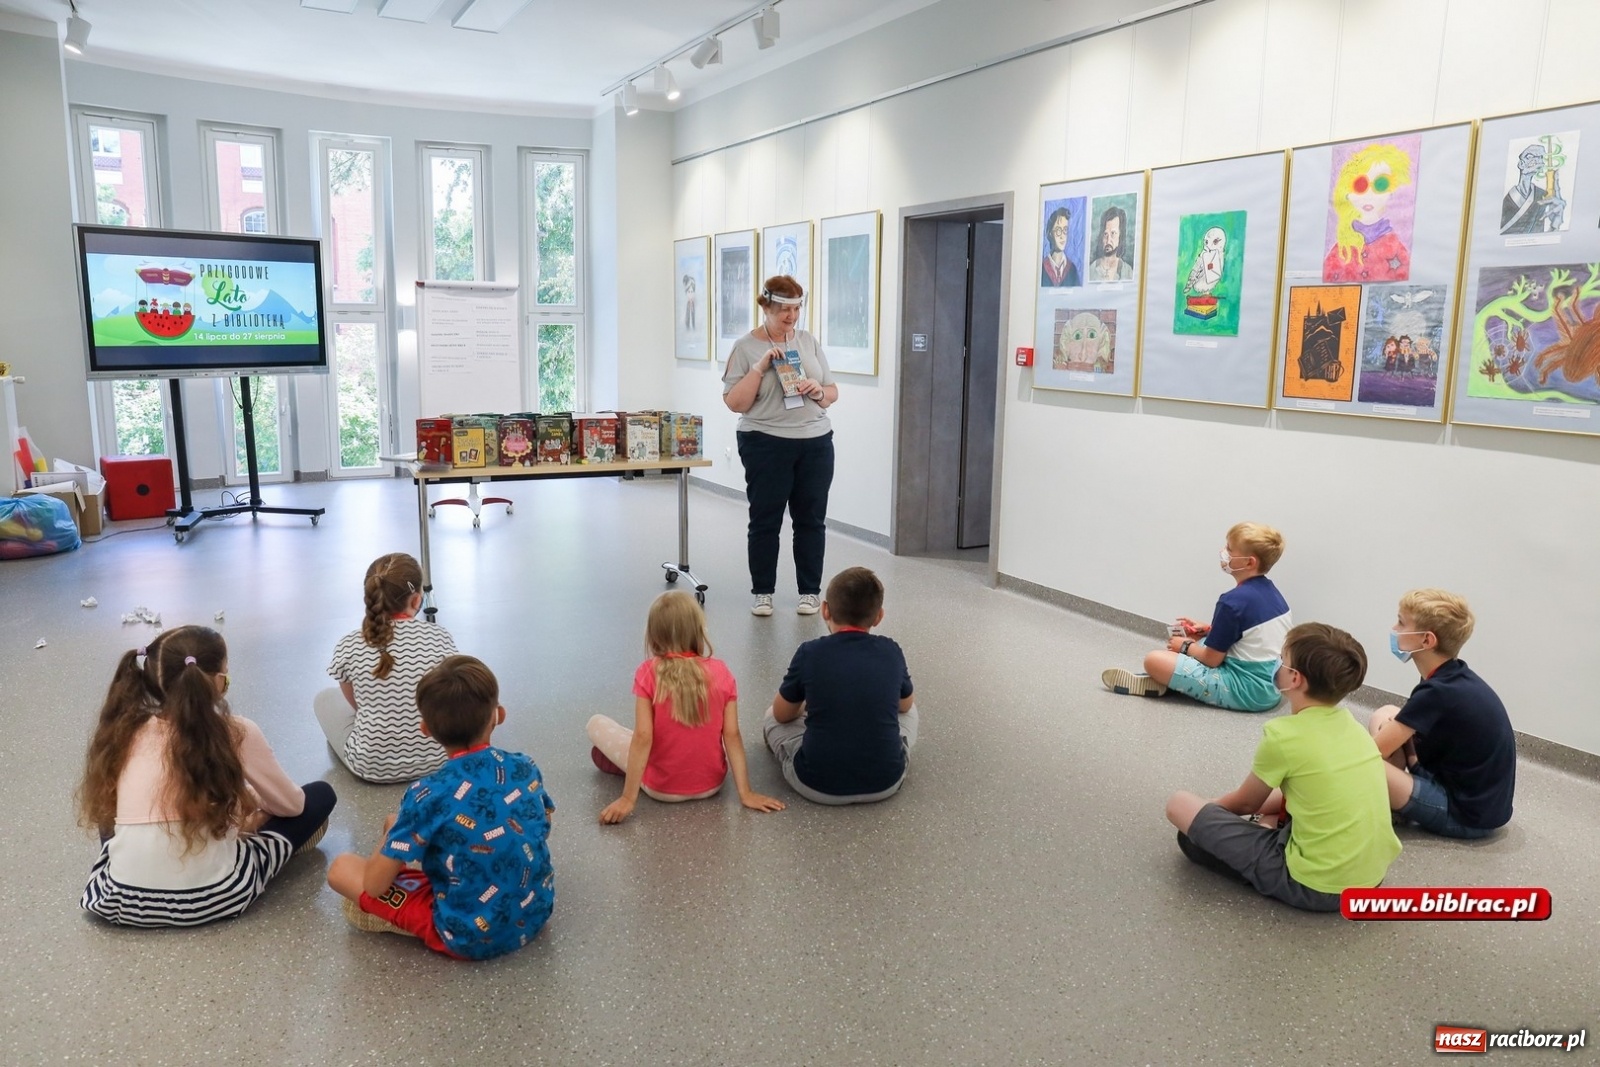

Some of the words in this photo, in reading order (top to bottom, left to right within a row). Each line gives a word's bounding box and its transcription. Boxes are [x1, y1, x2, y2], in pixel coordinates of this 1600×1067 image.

[199, 263, 270, 280] PRZYGODOWE
[206, 280, 248, 311] Lato
[212, 313, 217, 327] Z
[224, 313, 285, 329] BIBLIOTEKĄ
[194, 332, 204, 341] 14
[206, 332, 227, 342] lipca
[230, 332, 241, 341] do
[243, 332, 252, 341] 27
[254, 332, 285, 342] sierpnia
[454, 814, 477, 830] HULK
[483, 825, 506, 841] MARVEL
[390, 840, 410, 852] MARVEL
[478, 884, 499, 904] MARVEL
[474, 916, 490, 932] HULK
